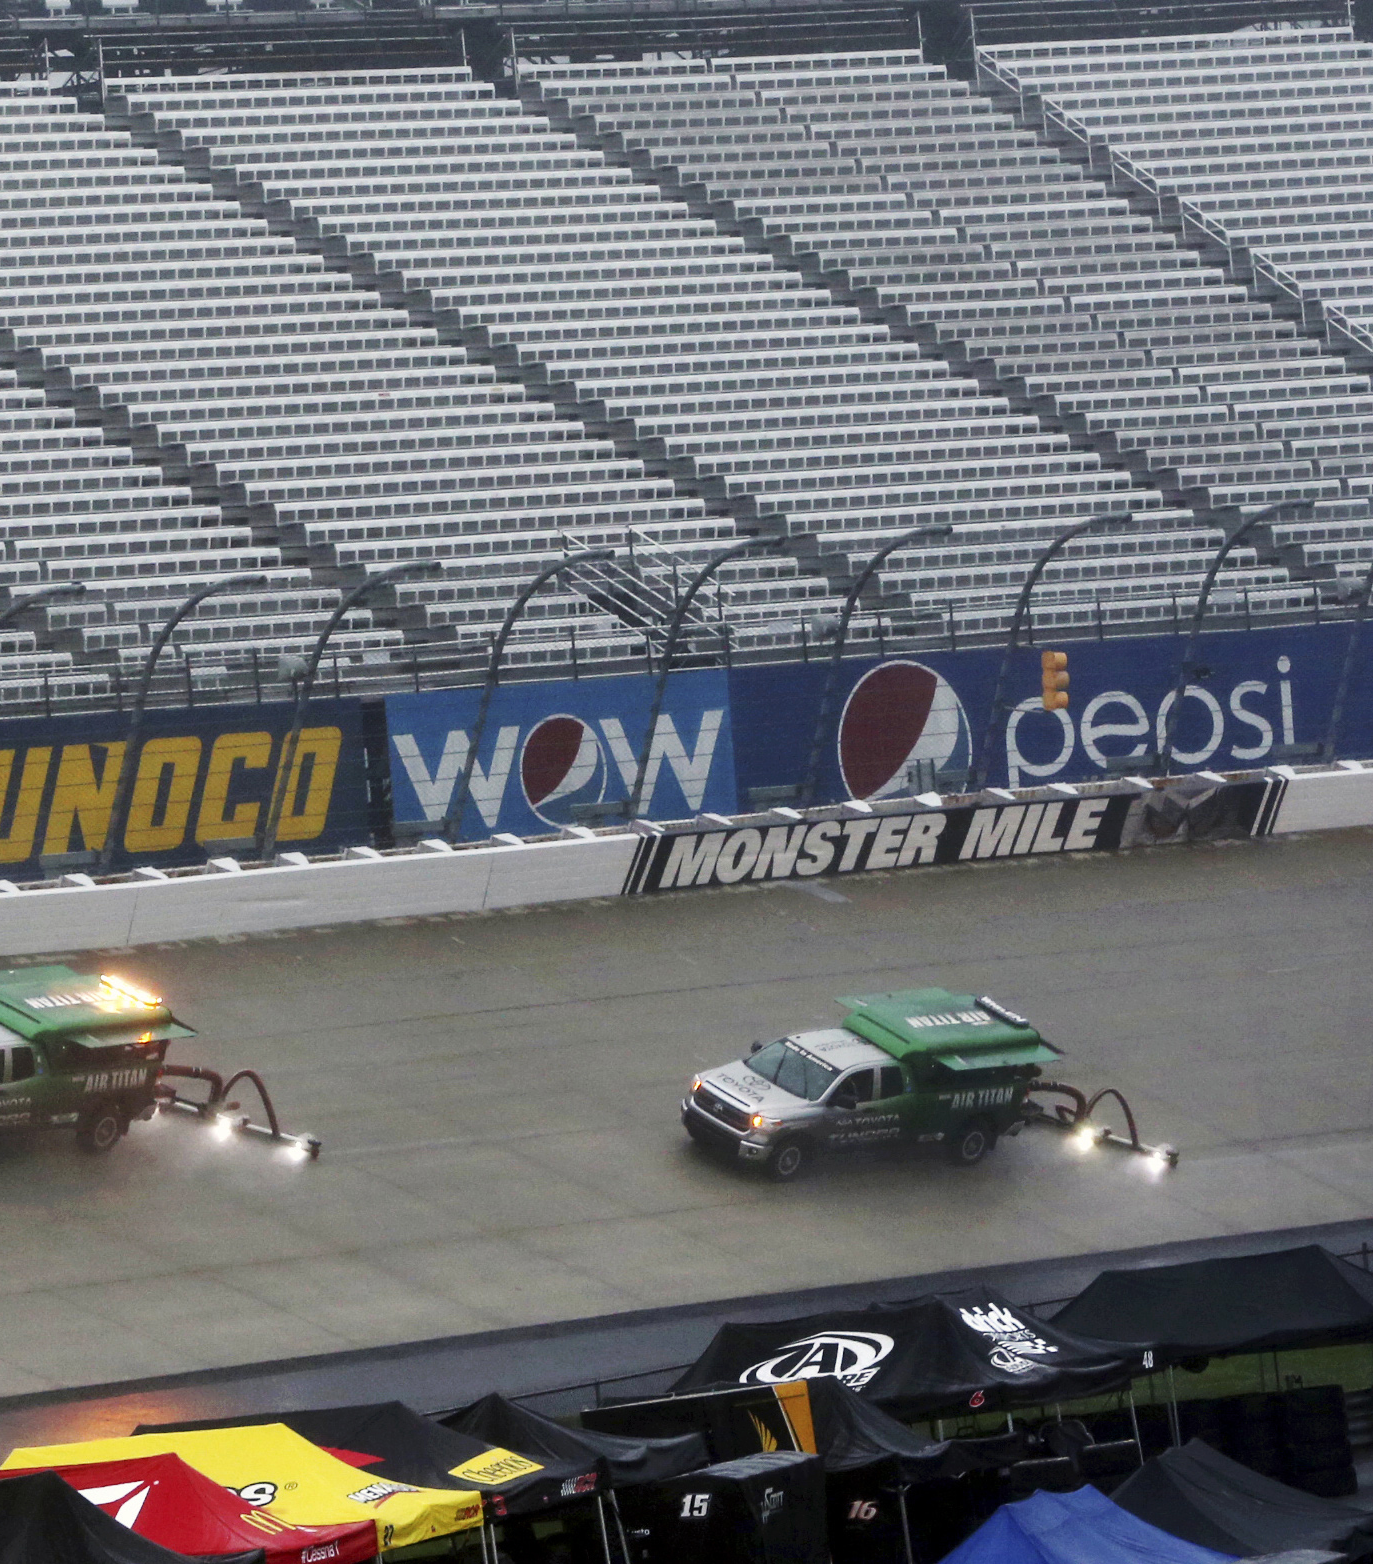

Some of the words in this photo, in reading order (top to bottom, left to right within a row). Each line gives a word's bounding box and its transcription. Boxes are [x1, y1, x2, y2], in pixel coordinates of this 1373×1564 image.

[1006, 655, 1295, 788] pepsi
[659, 812, 947, 889] MONSTER
[959, 797, 1110, 860] MILE
[84, 1074, 108, 1093] AIR
[112, 1068, 147, 1090] TITAN
[717, 1073, 765, 1103] TOYOTA
[950, 1091, 975, 1110] AIR
[978, 1085, 1014, 1107] TITAN
[969, 1390, 985, 1408] 6
[680, 1493, 710, 1518] 15
[847, 1500, 878, 1520] 16
